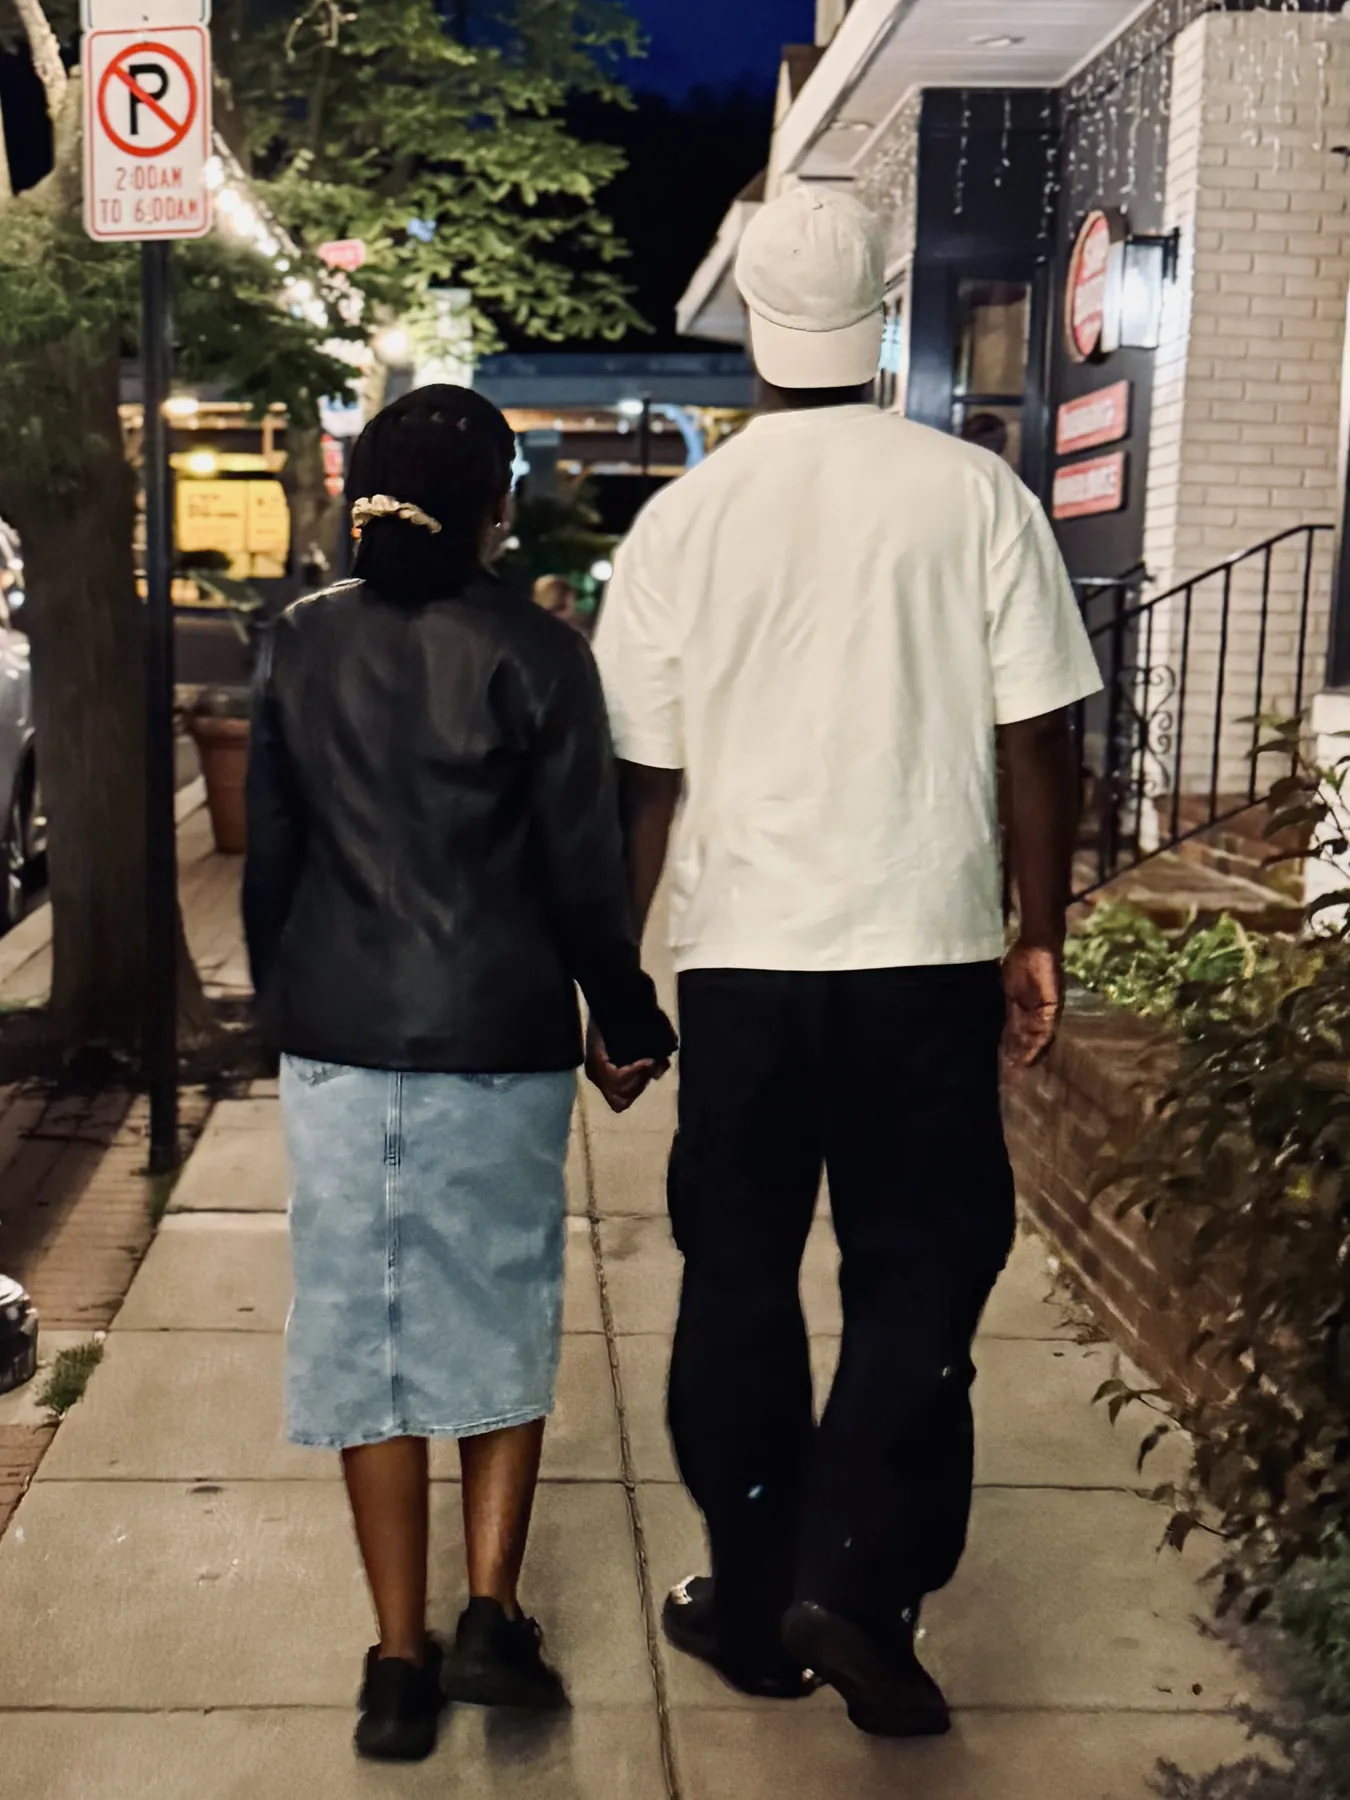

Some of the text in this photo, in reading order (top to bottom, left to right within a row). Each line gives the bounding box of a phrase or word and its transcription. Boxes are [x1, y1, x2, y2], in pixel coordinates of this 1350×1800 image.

[129, 63, 168, 135] P
[115, 165, 182, 191] 2:00AM
[100, 198, 122, 223] TO
